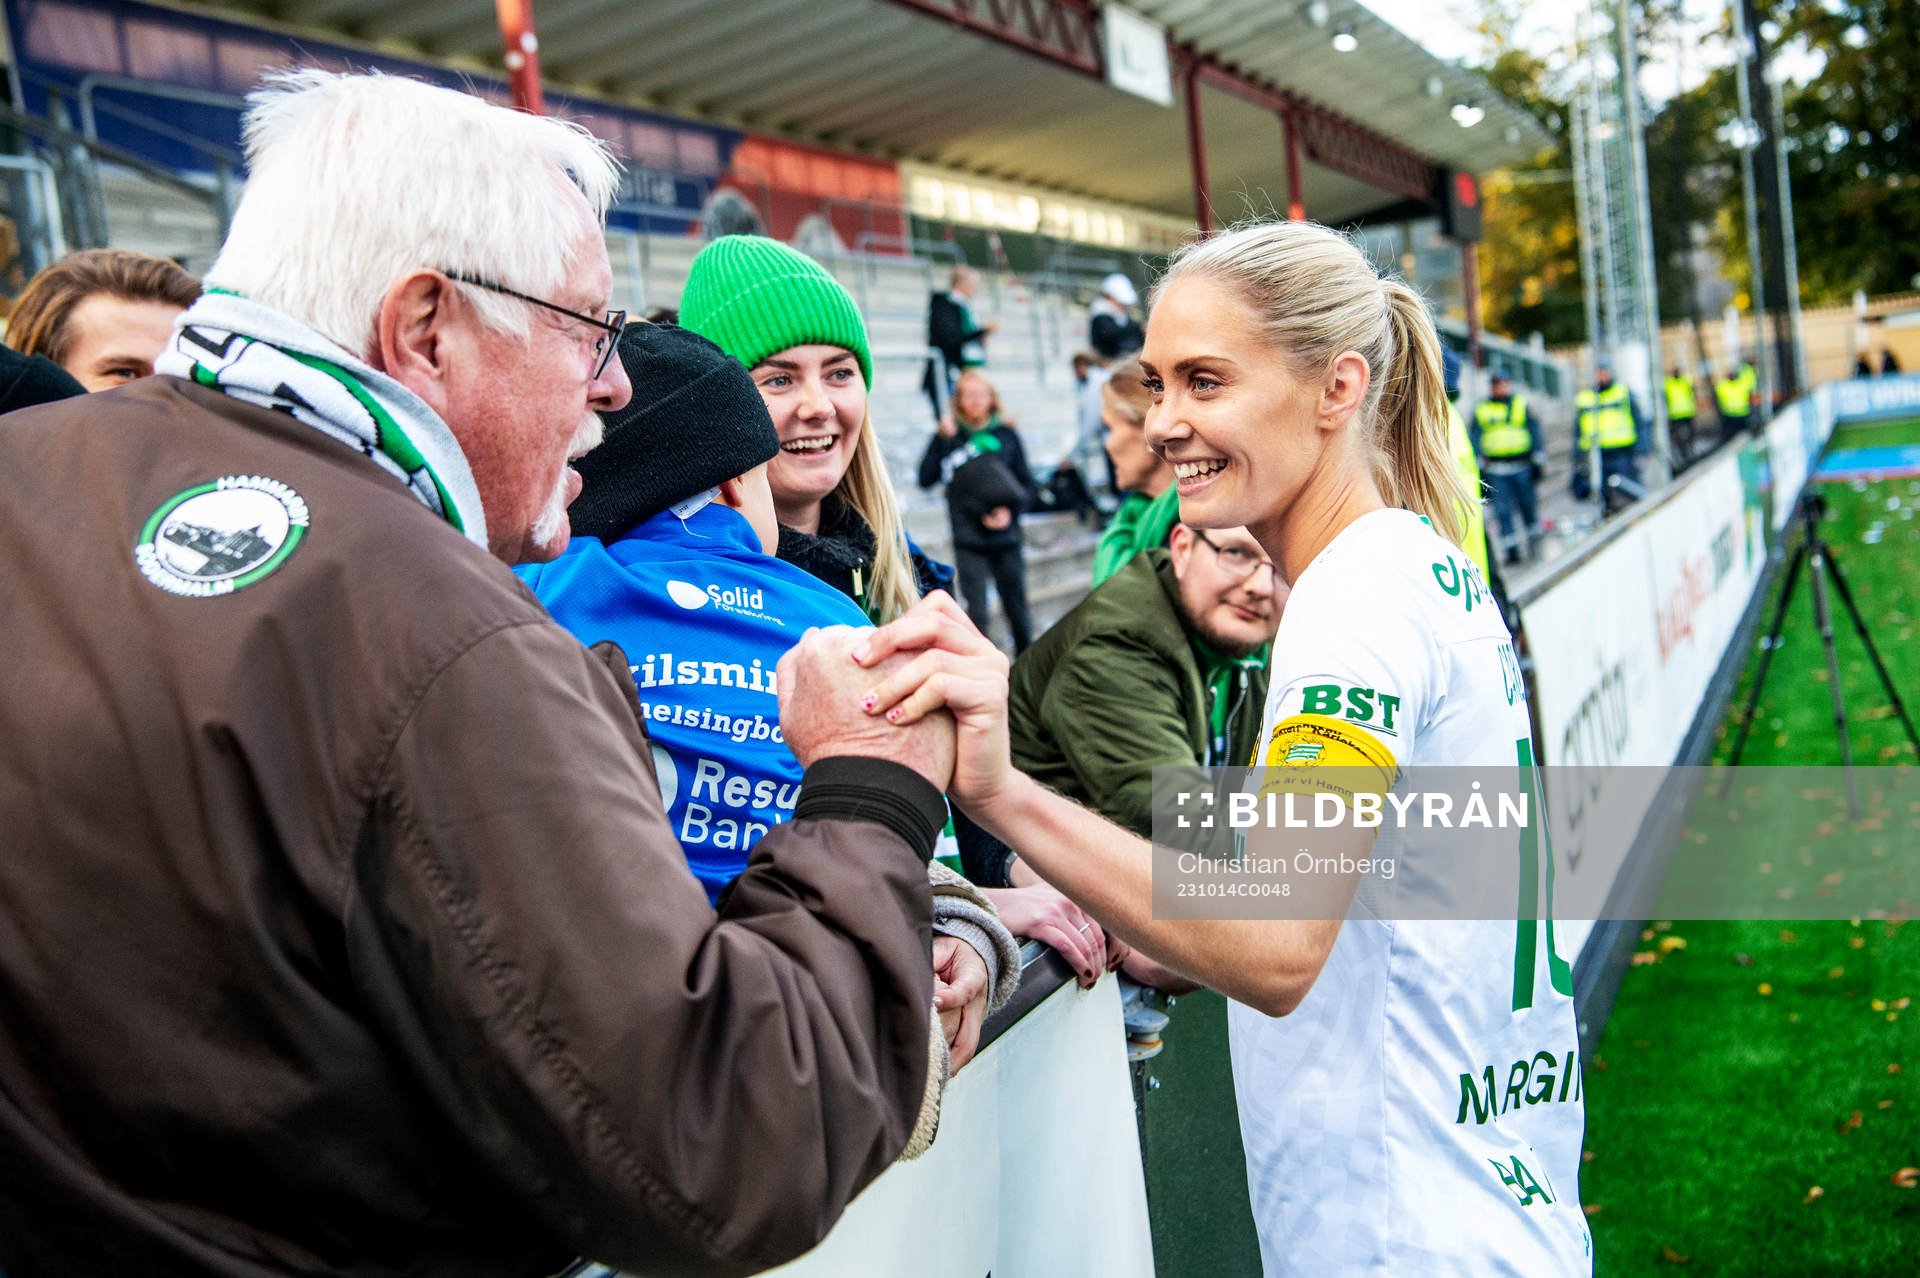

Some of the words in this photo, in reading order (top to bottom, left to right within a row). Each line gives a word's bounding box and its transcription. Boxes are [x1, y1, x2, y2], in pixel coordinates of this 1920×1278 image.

[706, 584, 763, 610] Solid
[1300, 684, 1401, 730] BST
[680, 802, 782, 851] Ban
[1488, 1155, 1557, 1207] BA
